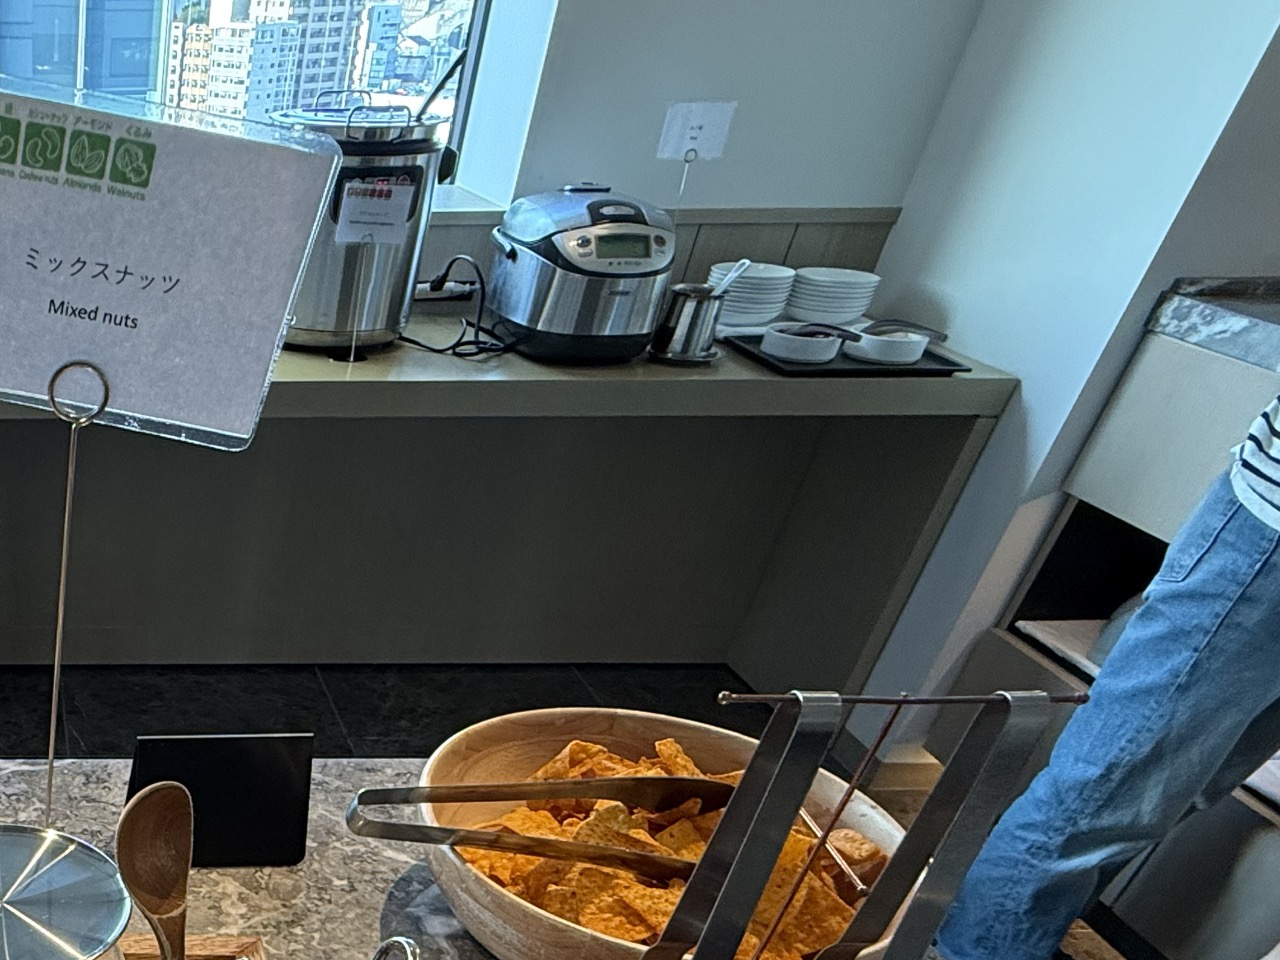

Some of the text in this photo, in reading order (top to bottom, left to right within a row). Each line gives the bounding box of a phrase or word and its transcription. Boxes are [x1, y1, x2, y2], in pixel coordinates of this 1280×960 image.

[62, 177, 102, 194] Almonds
[106, 185, 146, 202] Walnuts
[25, 247, 181, 294] ミックスナッツ
[47, 298, 139, 330] Mixed nuts
